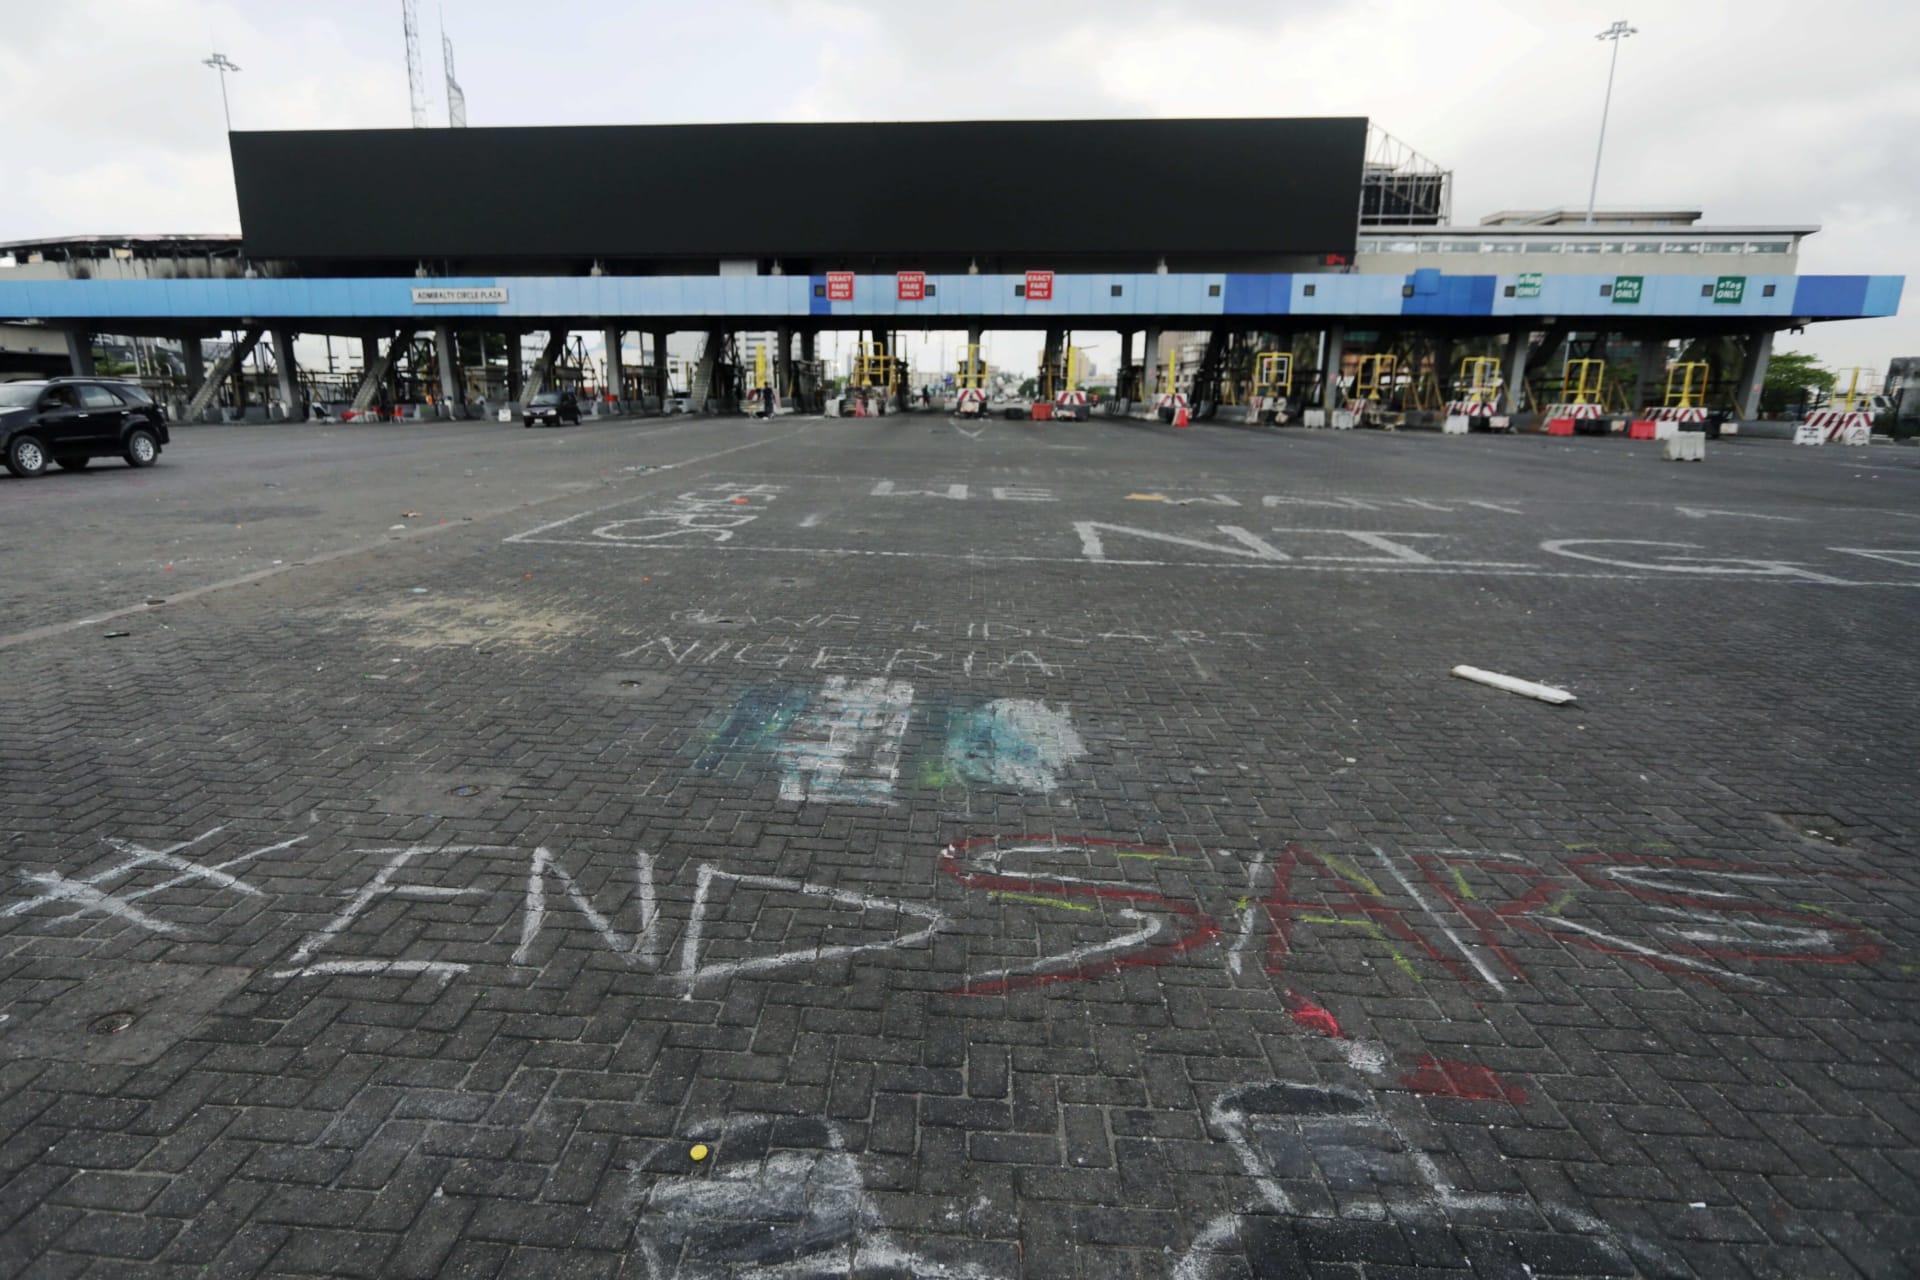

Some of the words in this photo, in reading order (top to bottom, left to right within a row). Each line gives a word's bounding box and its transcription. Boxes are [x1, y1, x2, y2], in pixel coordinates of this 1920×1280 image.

[417, 291, 454, 299] ADMIRALTY
[456, 291, 478, 299] CIRCLE
[480, 290, 502, 299] PLAZA
[1517, 287, 1540, 297] ONLY
[1615, 289, 1640, 298] ONLY
[1716, 290, 1741, 299] ONLY
[868, 478, 1058, 503] WE
[616, 636, 1077, 678] NIGERIA
